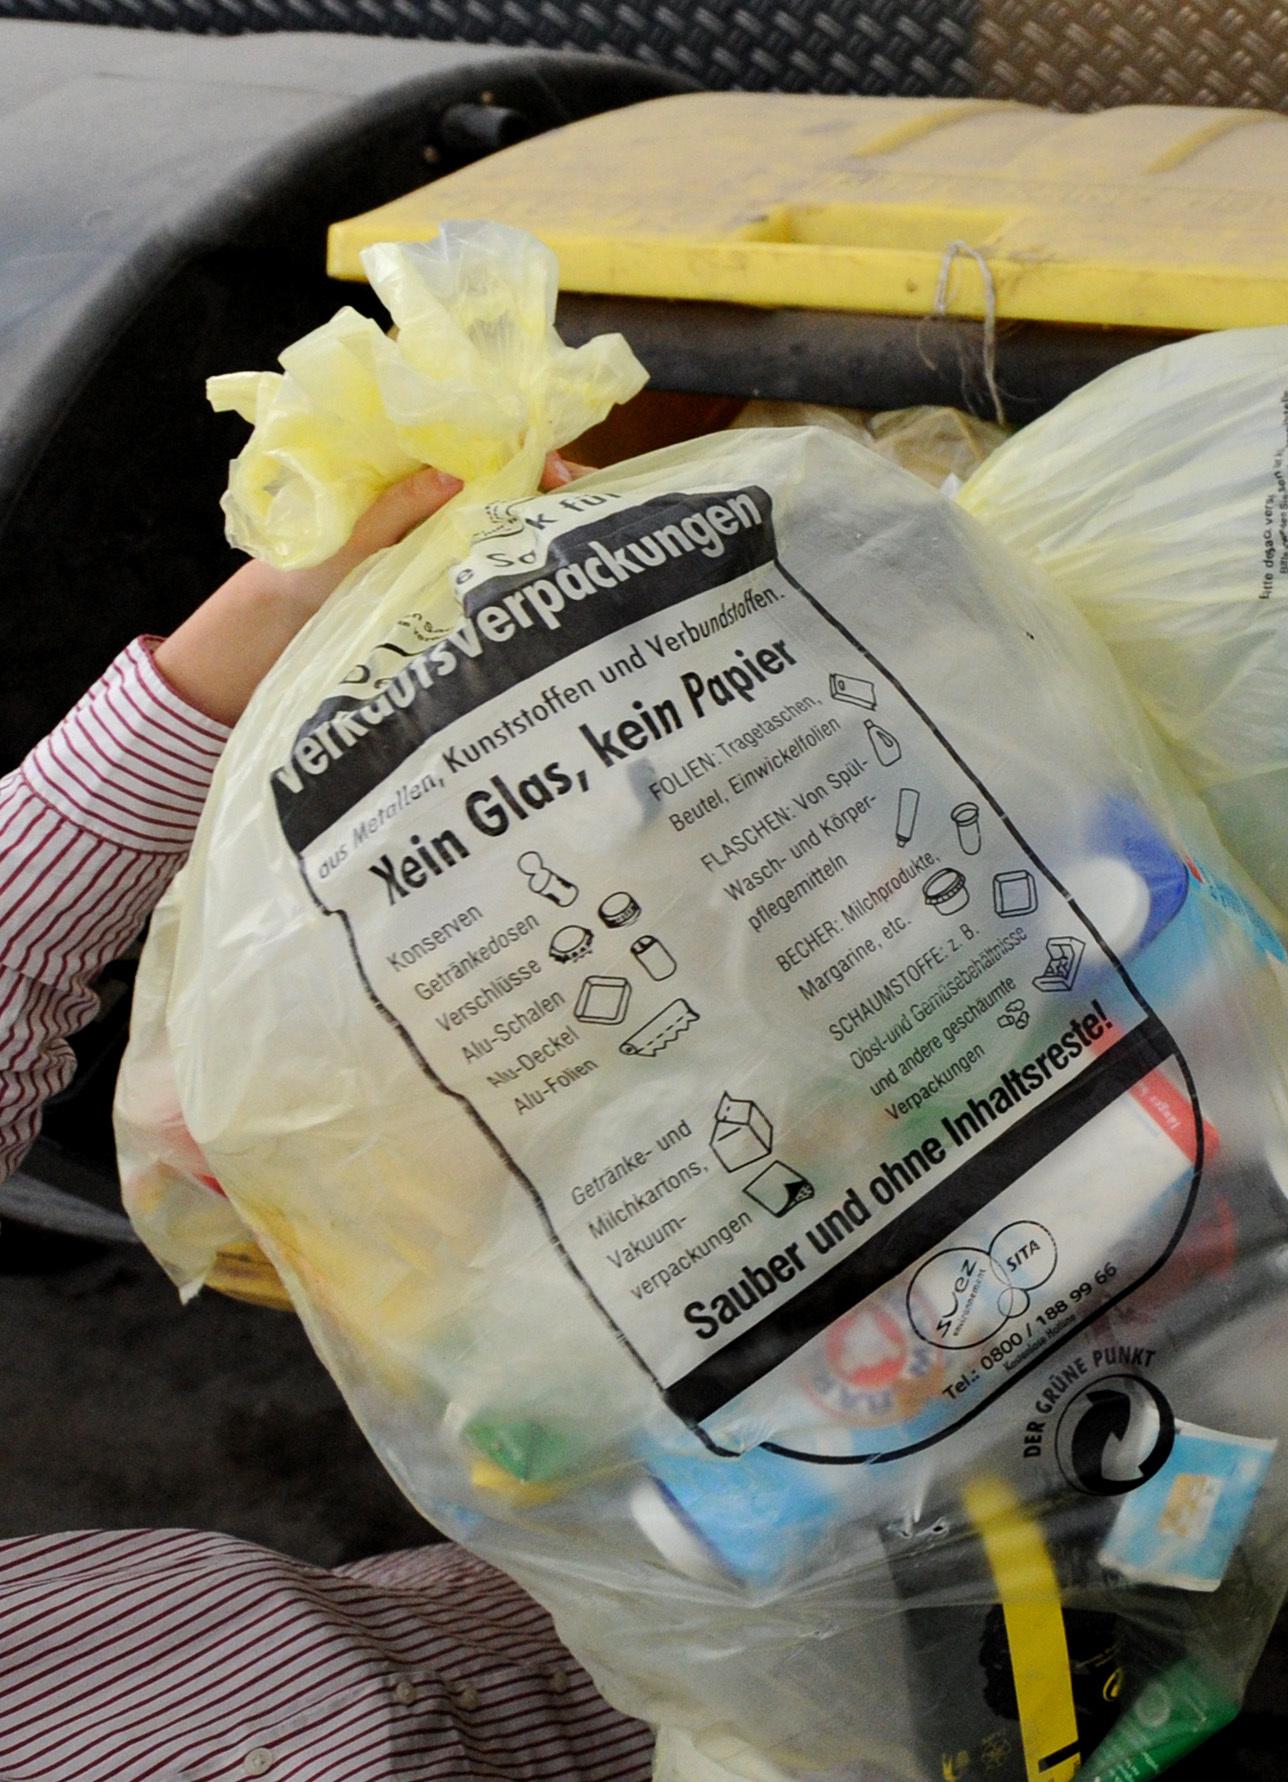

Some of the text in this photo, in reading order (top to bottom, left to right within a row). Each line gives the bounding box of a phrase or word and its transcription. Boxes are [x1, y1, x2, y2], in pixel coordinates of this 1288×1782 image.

[317, 844, 349, 881] aus
[350, 769, 447, 850] Metallen,
[443, 674, 597, 774] Kunststoffen
[597, 651, 649, 686] und
[645, 585, 788, 660] Verbundstoffen.
[464, 760, 592, 838] Glas,
[577, 692, 684, 769] kein
[679, 636, 799, 720] Papier
[648, 695, 823, 803] FOLIEN: Tragetaschen,
[668, 716, 843, 833] Beutel, Einwickelfolien
[700, 757, 869, 873] FLASCHEN: Von Spül-
[722, 793, 878, 903] Wasch- und Körper-
[747, 853, 850, 934] pflegemitteln
[775, 849, 942, 973] BECHER: Milchprodukte,
[385, 904, 484, 974] Konserven
[413, 912, 541, 1002] Getränkedosen
[797, 915, 913, 1001] Margarine, etc.
[828, 922, 981, 1043] SCHAUMSTOFFE: z. B.
[909, 925, 1029, 1024] Gemüsebehältnisse
[434, 956, 543, 1033] Verschlüsse
[460, 988, 566, 1065] Alu-Schalen
[868, 975, 1018, 1098] und andere geschäumte
[485, 1024, 581, 1089] Alu-Deckel
[512, 1058, 600, 1116] Alu-Folien
[883, 1043, 987, 1121] Verpackungen
[571, 1118, 693, 1207] Getränke- und
[587, 1159, 710, 1240] Milchkartons,
[682, 998, 1114, 1341] Sauber und ohne Inhaltsreste!
[604, 1216, 689, 1270] Vakuum-
[630, 1210, 754, 1300] verpackungen
[1005, 1239, 1042, 1274] SITA
[941, 1261, 1119, 1402] Tel.: 0800 / 188 99 66
[1003, 1336, 1047, 1374] Kostenlose
[1023, 1345, 1156, 1459] DER GRÜNE PUNKT
